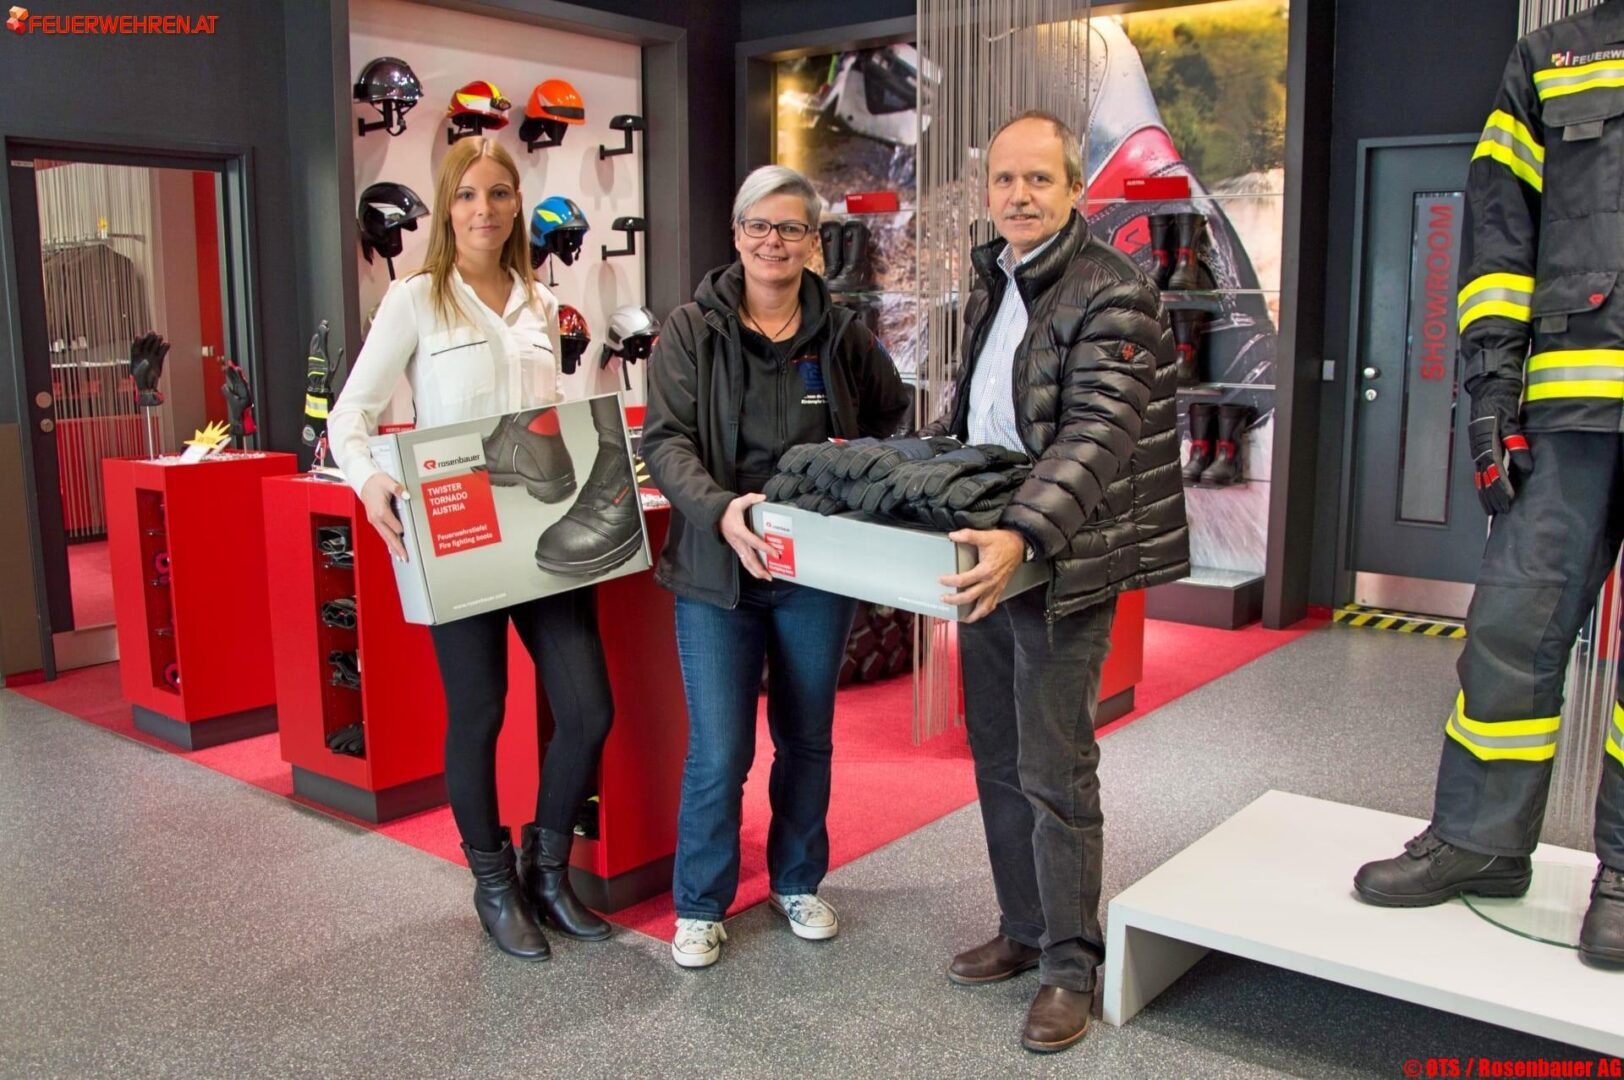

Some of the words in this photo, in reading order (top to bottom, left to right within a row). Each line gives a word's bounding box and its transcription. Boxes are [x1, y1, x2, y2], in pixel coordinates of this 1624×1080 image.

[1420, 204, 1455, 382] SHOWROOM
[437, 454, 481, 469] rosenbauer
[427, 482, 463, 496] TWISTER
[429, 491, 469, 506] TORNADO
[432, 502, 466, 517] AUSTRIA
[439, 539, 452, 550] Fire
[452, 534, 476, 548] fighting
[476, 531, 494, 542] boots
